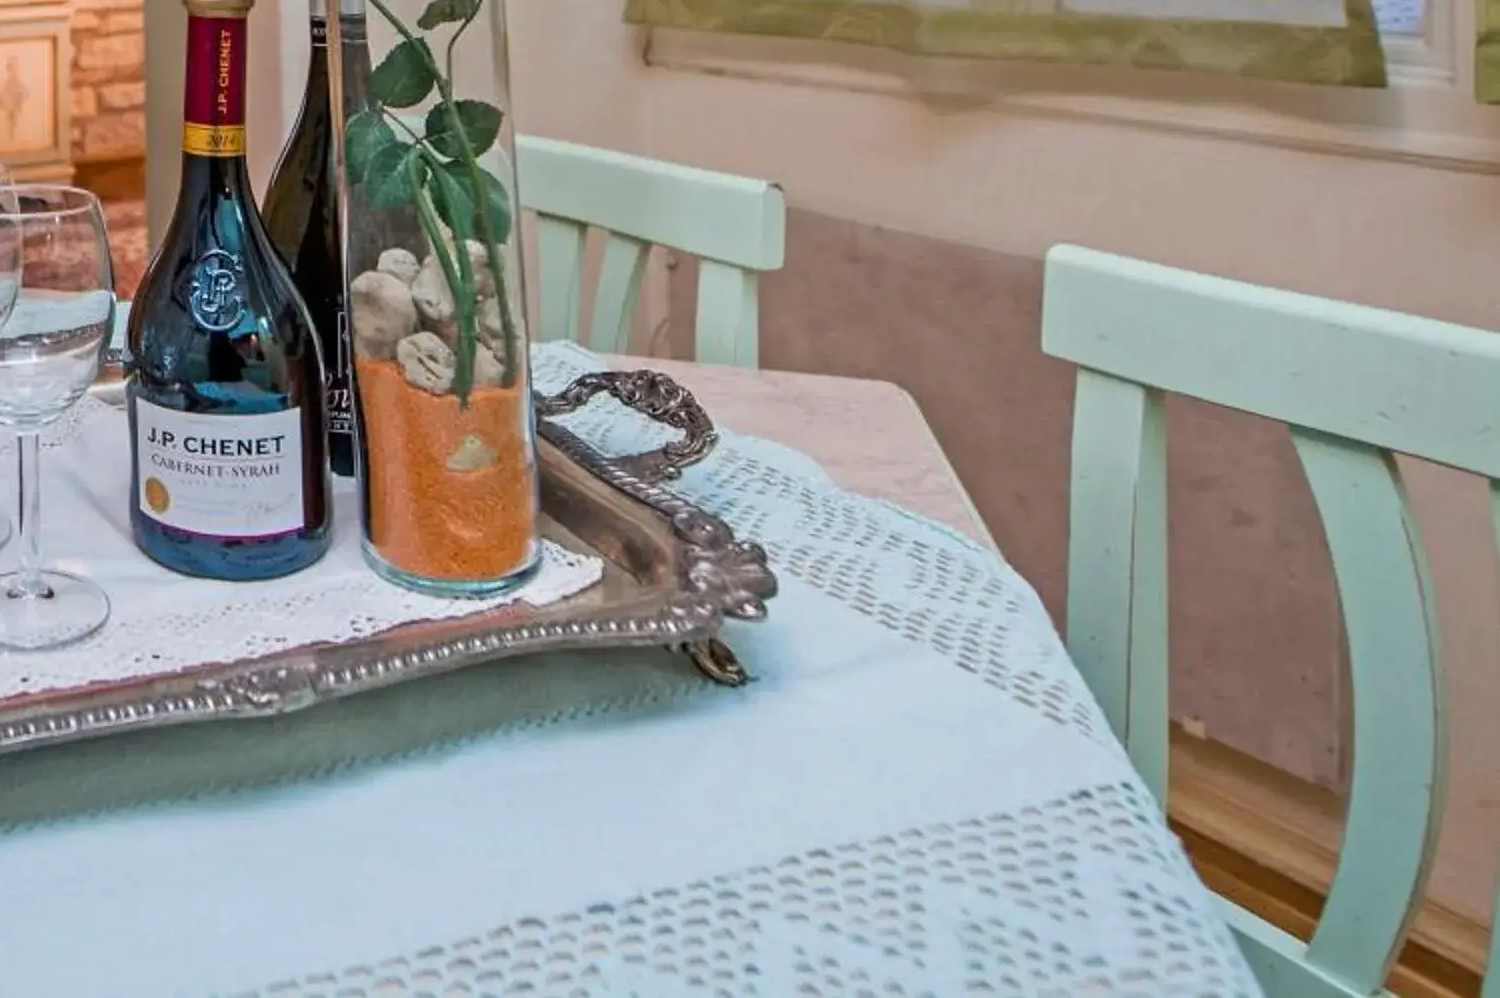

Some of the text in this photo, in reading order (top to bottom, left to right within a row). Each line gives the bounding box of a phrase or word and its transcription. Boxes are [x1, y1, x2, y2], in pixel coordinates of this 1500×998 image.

[218, 29, 232, 87] CHENET
[147, 427, 286, 457] J.P. CHENET
[151, 452, 280, 478] CABERNET-SYRAH
